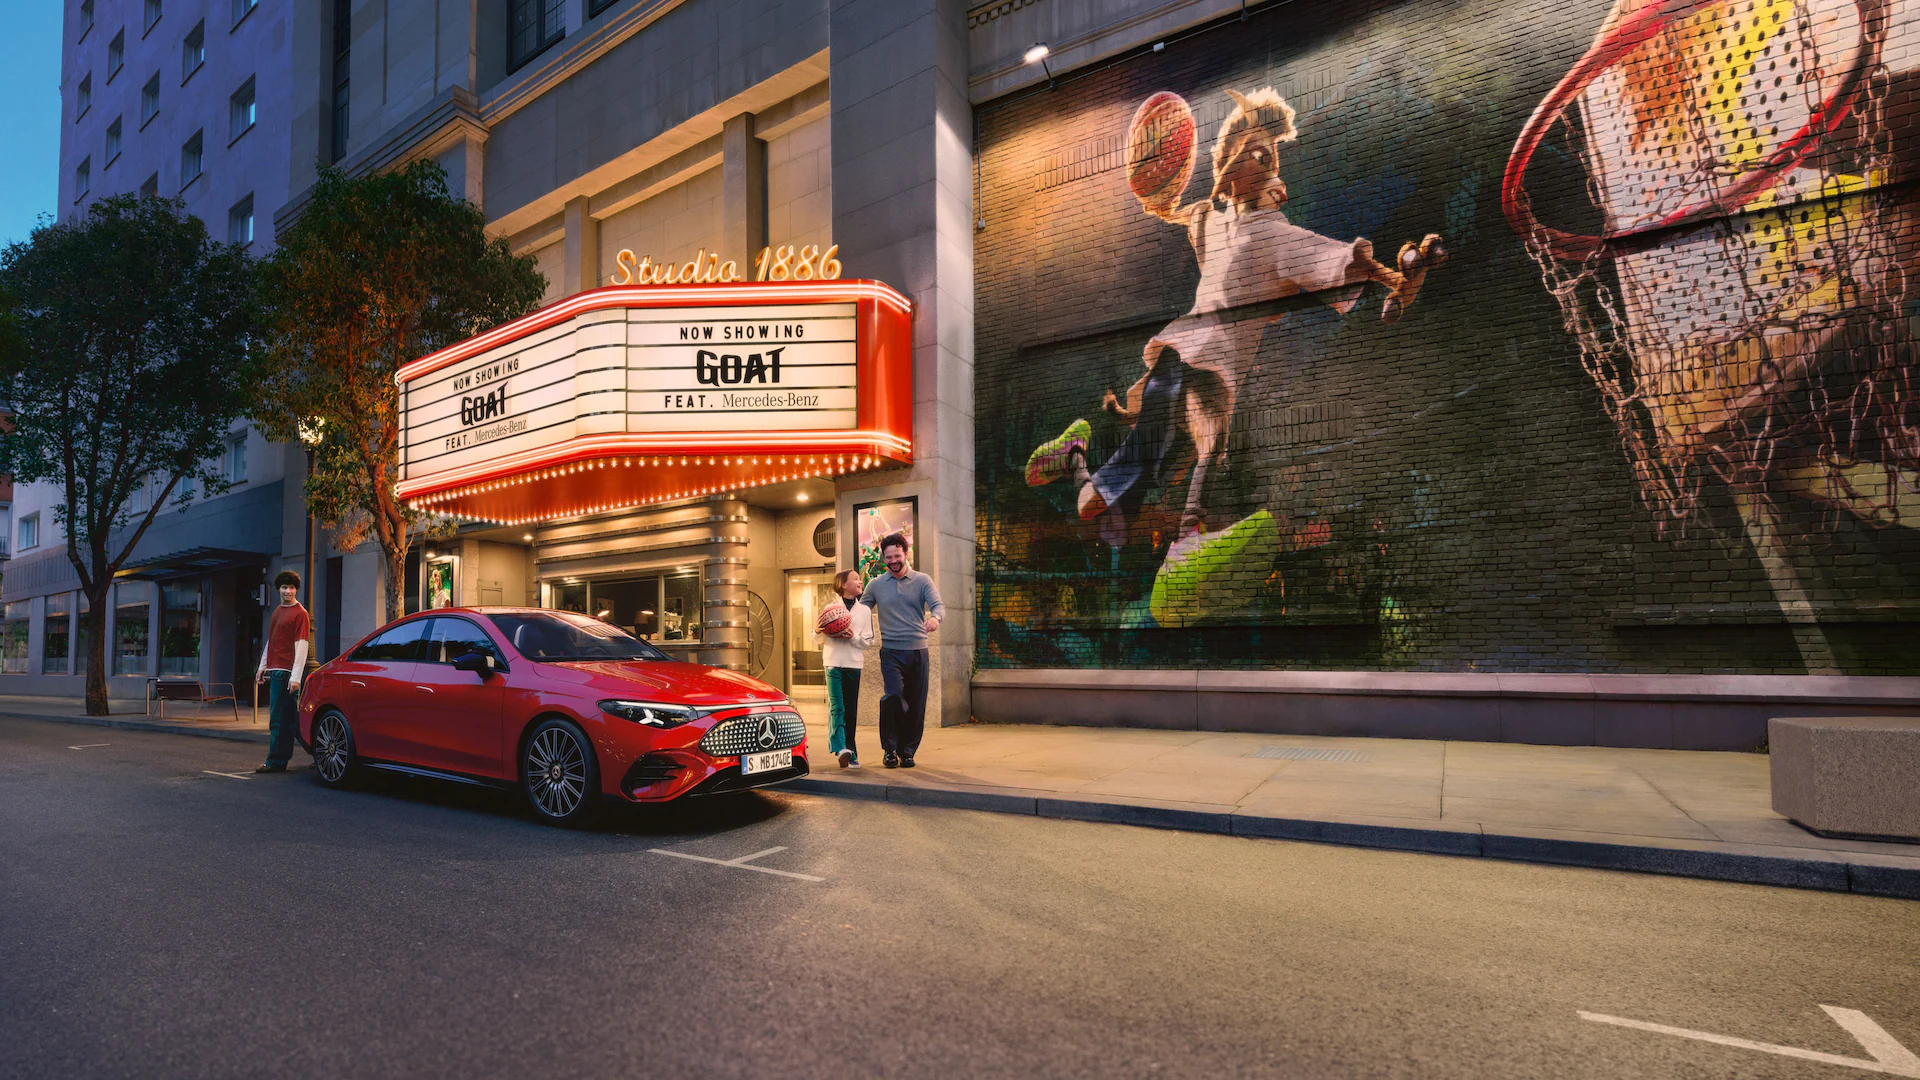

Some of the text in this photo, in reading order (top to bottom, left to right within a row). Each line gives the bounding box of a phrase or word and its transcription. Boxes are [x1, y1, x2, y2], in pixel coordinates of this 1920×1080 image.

[609, 244, 843, 286] Studio 1886
[680, 324, 804, 340] NOW SHOWING
[453, 358, 519, 391] NOW SHOWING
[696, 346, 786, 387] GOAT
[461, 381, 509, 426] GOAT
[664, 392, 819, 408] FEAT. Mercedes-Benz
[445, 419, 527, 450] FEAT. Mercedes-Benz
[748, 757, 754, 771] S
